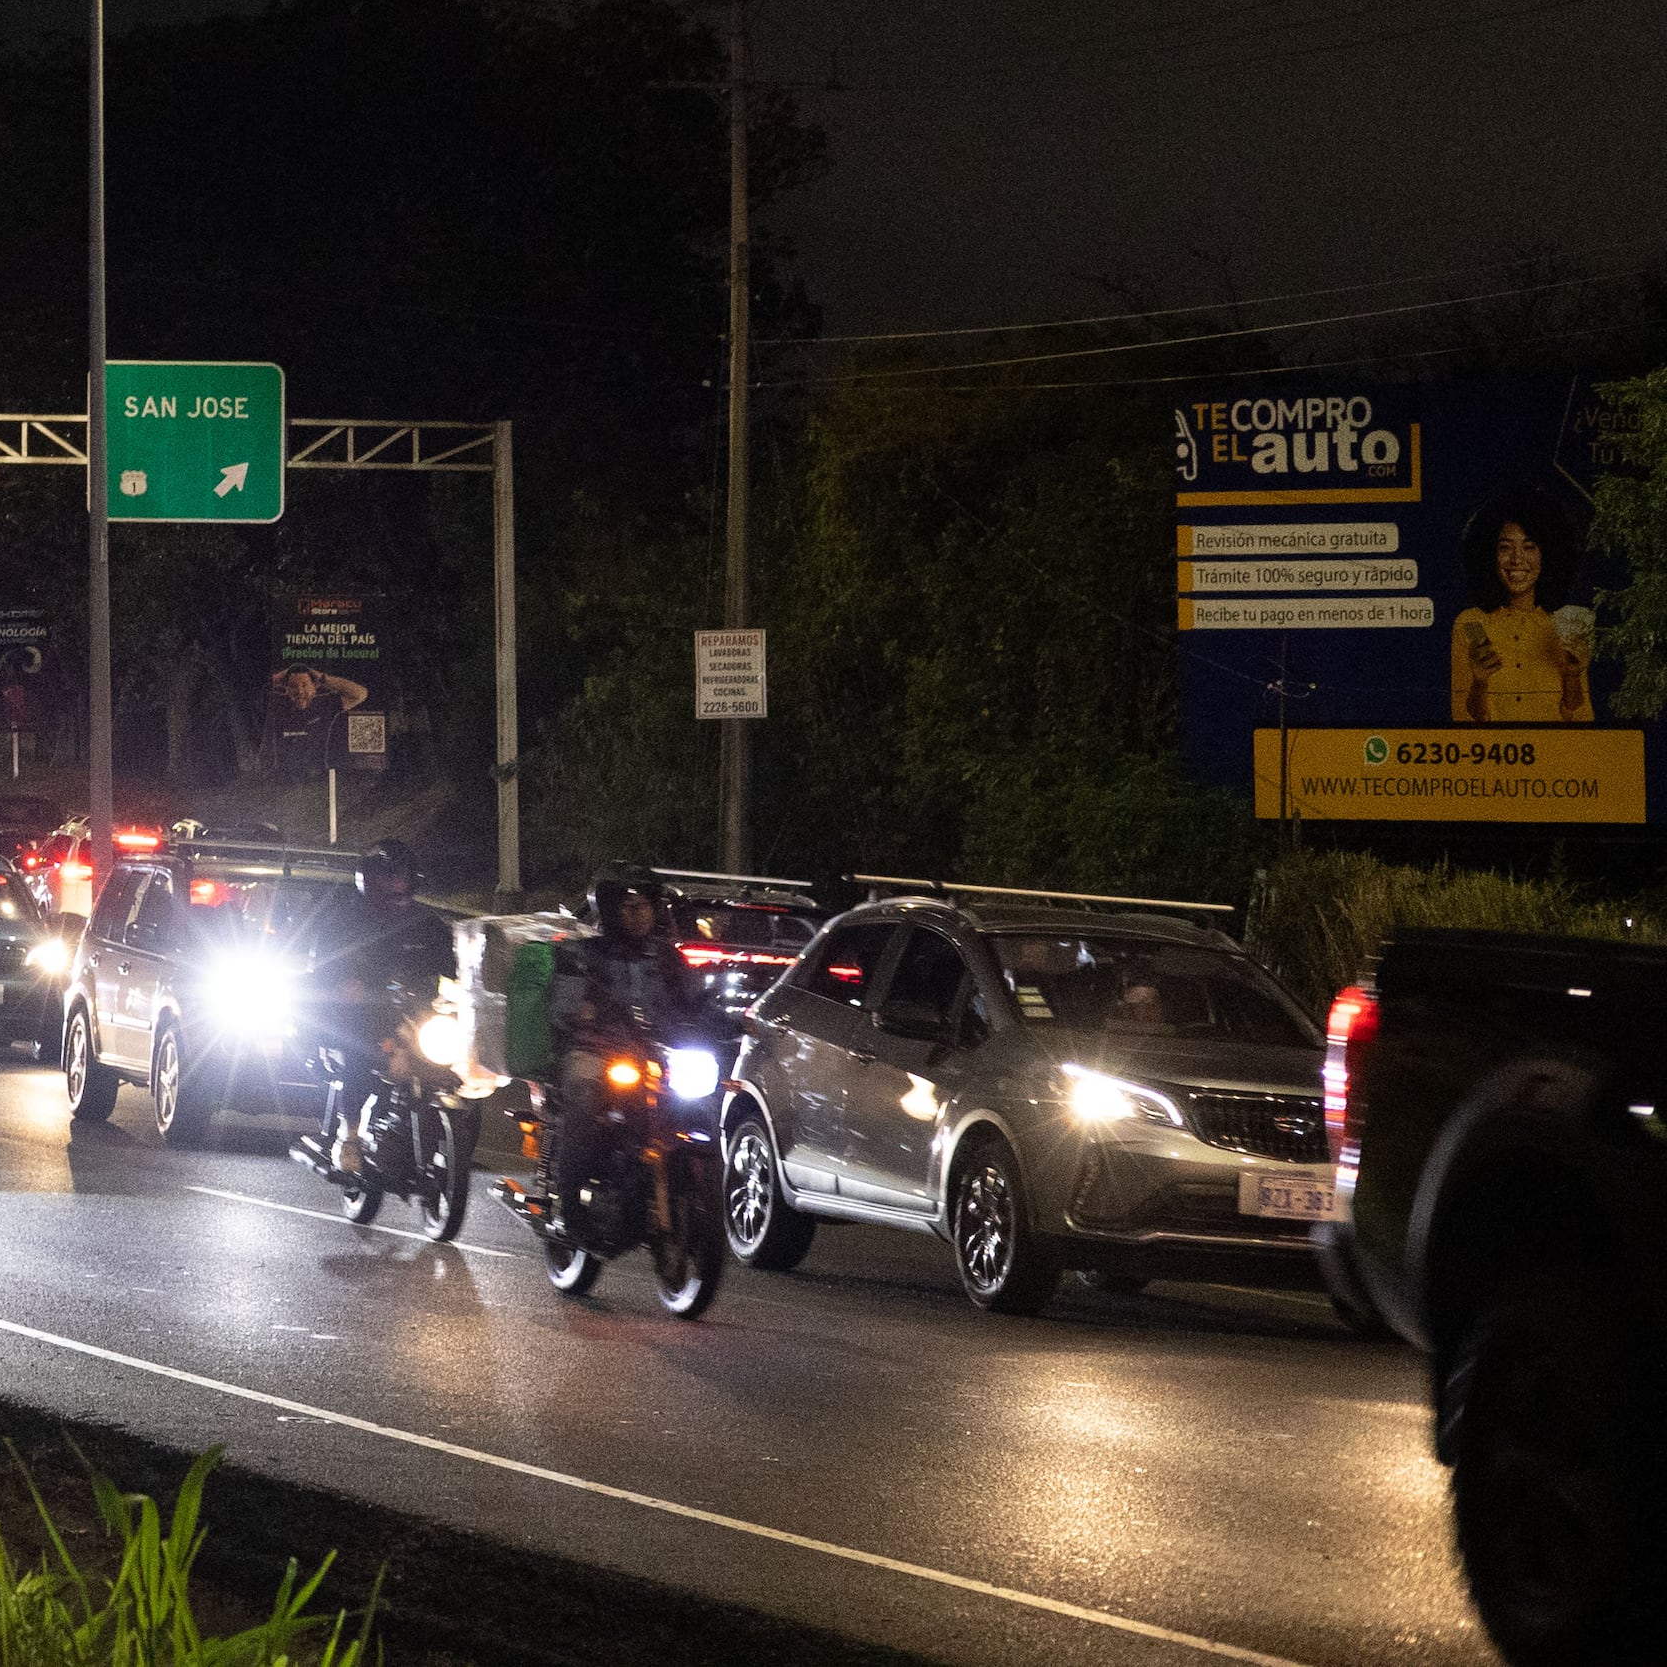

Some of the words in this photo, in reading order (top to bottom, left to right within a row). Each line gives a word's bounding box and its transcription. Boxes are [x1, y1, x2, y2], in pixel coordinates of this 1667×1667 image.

[124, 396, 177, 419] SAN
[187, 396, 250, 419] JOSE
[1196, 531, 1255, 549] Revisión
[1259, 531, 1326, 547] mecánica
[1331, 531, 1388, 550] gratuita
[1197, 567, 1250, 584] Trámite
[1255, 568, 1295, 584] 100%
[1299, 570, 1350, 587] seguro
[1352, 570, 1362, 585] y
[1365, 566, 1414, 586] rápido
[1196, 605, 1241, 622] Recibe
[1243, 607, 1257, 622] tu
[1260, 609, 1295, 626] pago
[1298, 609, 1315, 621] en
[1318, 608, 1364, 621] menos
[1367, 605, 1385, 620] de
[1389, 606, 1395, 620] 1
[1400, 605, 1432, 620] hora
[285, 634, 326, 645] TIENDA
[327, 634, 348, 645] DEL
[350, 632, 376, 645] PAÍS
[304, 623, 318, 633] LA
[320, 623, 357, 634] MEJOR
[701, 634, 759, 647] REPARAMOS
[703, 700, 759, 713] 2226-5600
[1396, 742, 1536, 765] 6230-9408
[1301, 777, 1599, 799] WWW.TECOMPROELAUTO.COM
